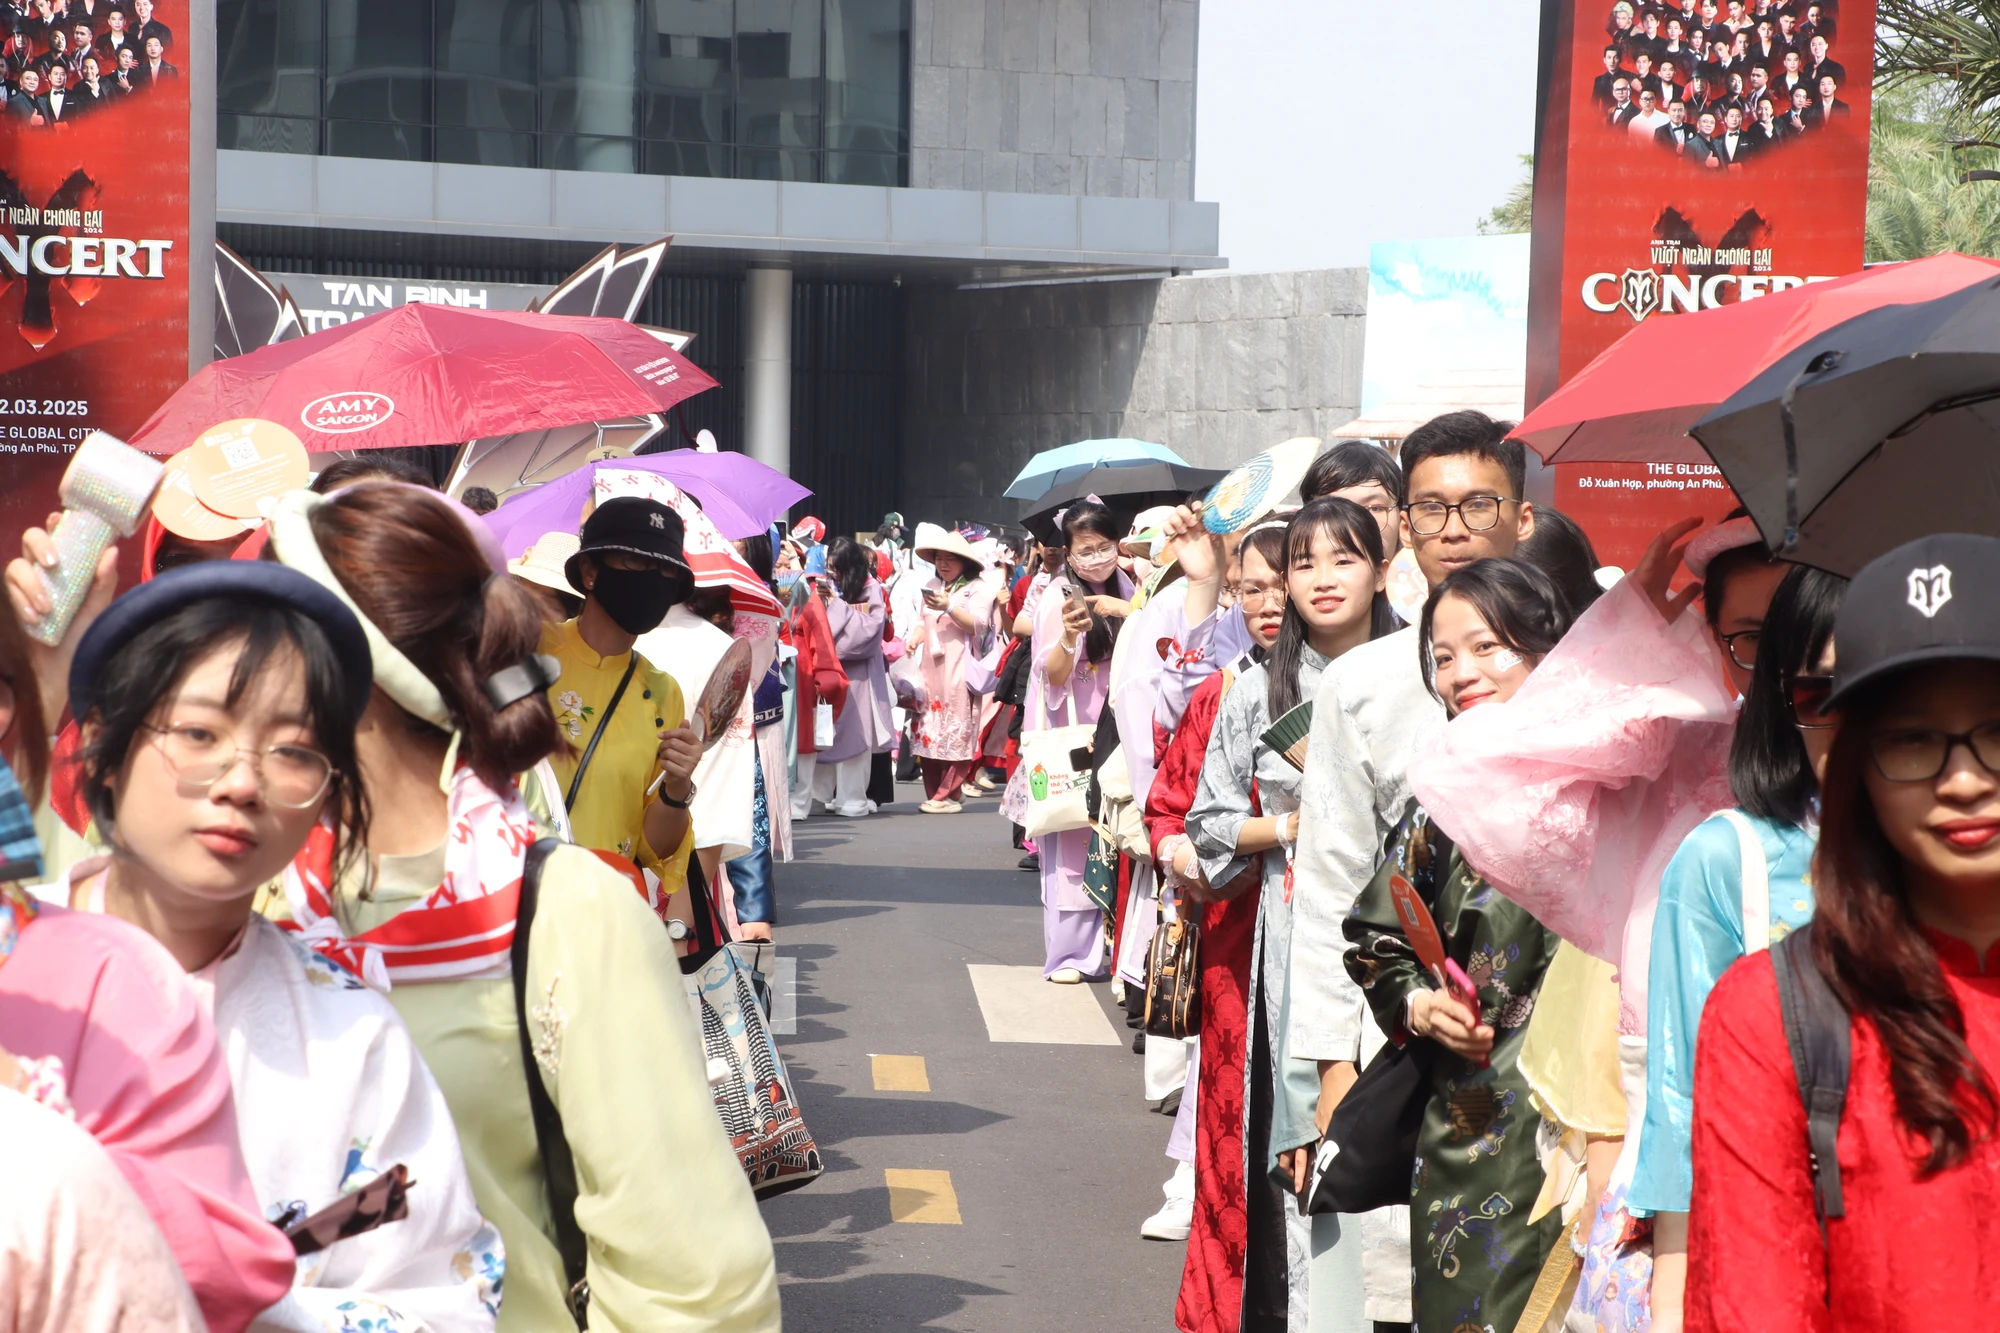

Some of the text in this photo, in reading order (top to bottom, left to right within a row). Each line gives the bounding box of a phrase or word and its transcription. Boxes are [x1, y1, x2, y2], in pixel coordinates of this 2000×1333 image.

[9, 203, 40, 226] NGÀN
[43, 208, 80, 227] CHÔNG
[84, 209, 103, 228] GAI
[0, 234, 174, 279] NCERT
[1682, 244, 1712, 266] NGÀN
[1715, 247, 1751, 266] CHÔNG
[1753, 248, 1773, 266] GAI
[322, 281, 393, 308] TAN
[0, 398, 88, 416] 2.03.2025
[318, 397, 380, 414] AMY
[315, 413, 378, 426] SAIGON
[9, 426, 66, 440] GLOBAL
[20, 443, 34, 453] An
[1647, 463, 1722, 475] THE GLOBA
[1595, 478, 1620, 488] Xuân
[1646, 478, 1685, 490] phường
[1686, 479, 1701, 489] An
